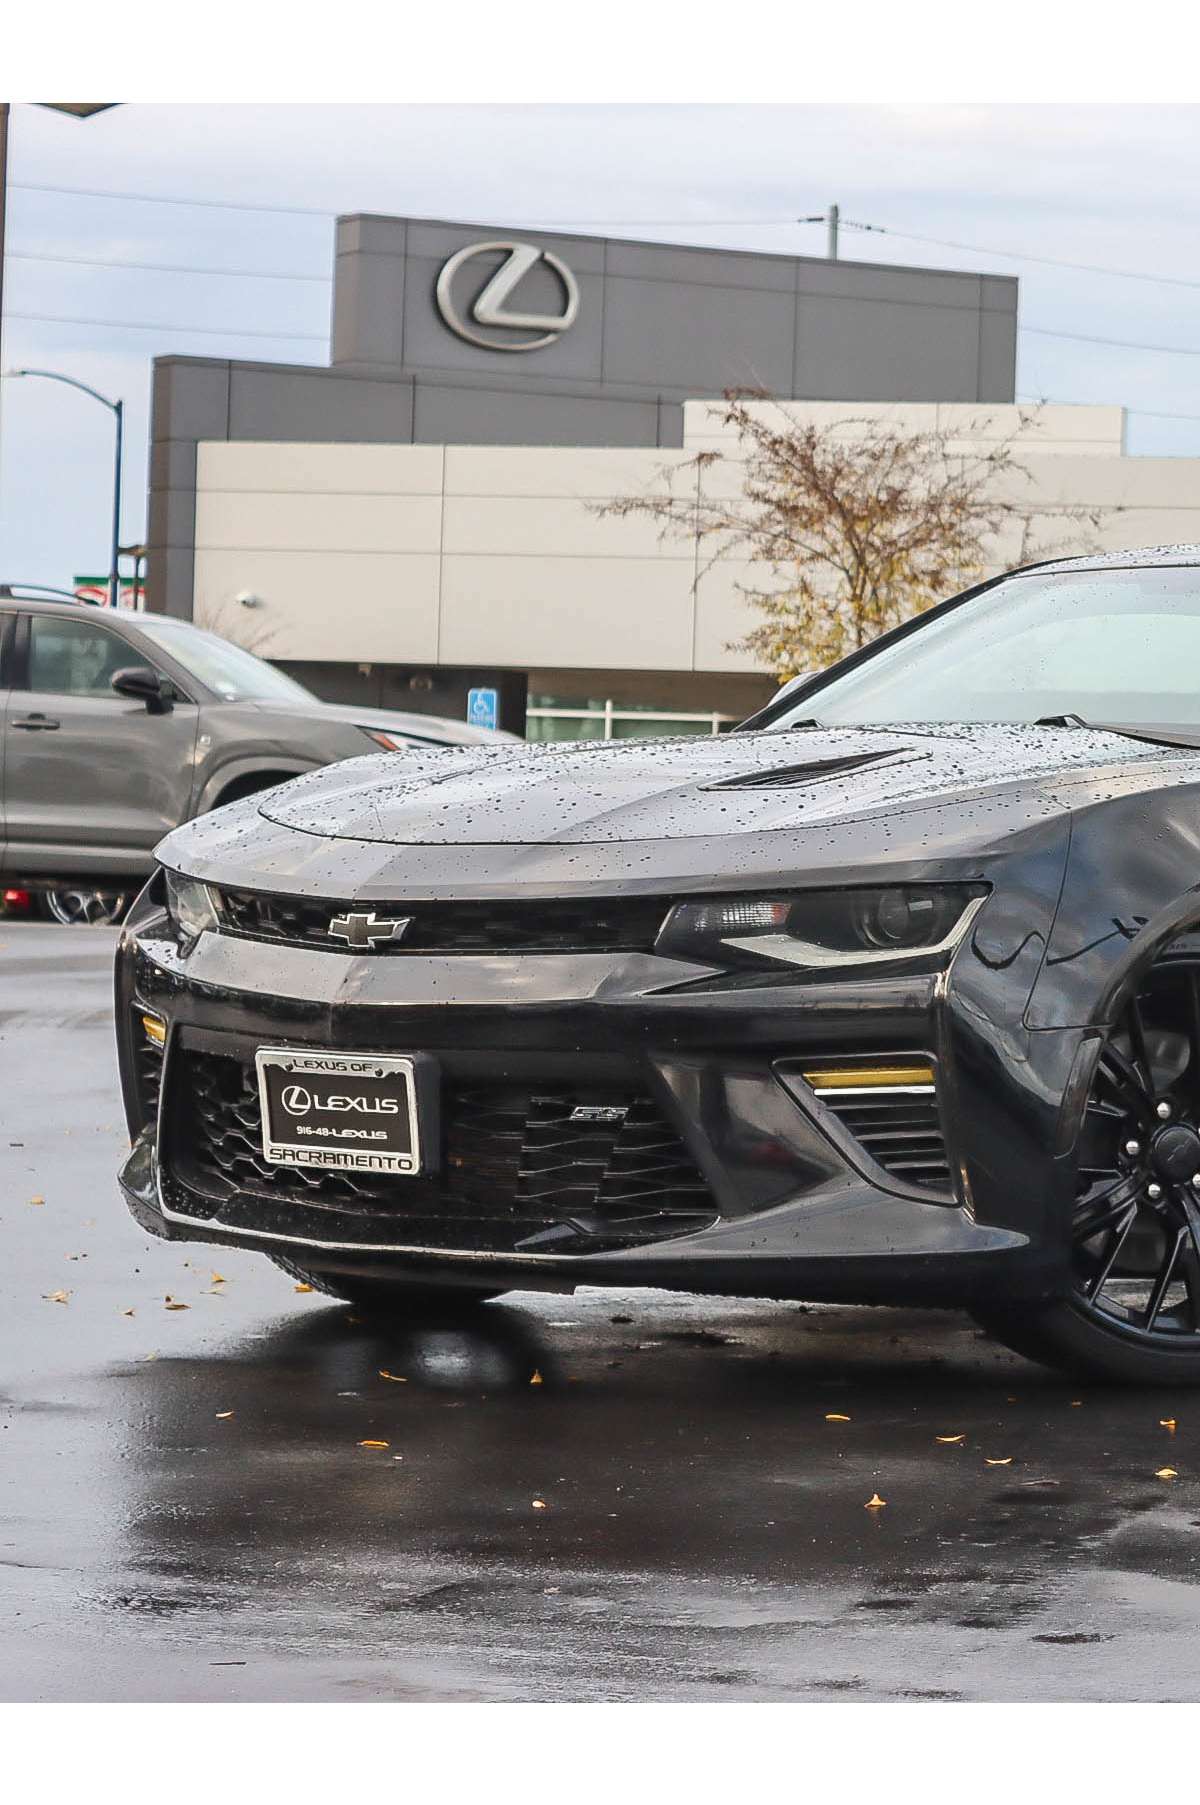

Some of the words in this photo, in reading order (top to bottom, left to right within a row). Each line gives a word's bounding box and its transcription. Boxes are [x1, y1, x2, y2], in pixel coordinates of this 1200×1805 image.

[293, 1059, 347, 1071] LEXUS
[350, 1063, 373, 1071] OF
[313, 1094, 399, 1114] LEXUS
[270, 1148, 413, 1170] SACRAMENTO
